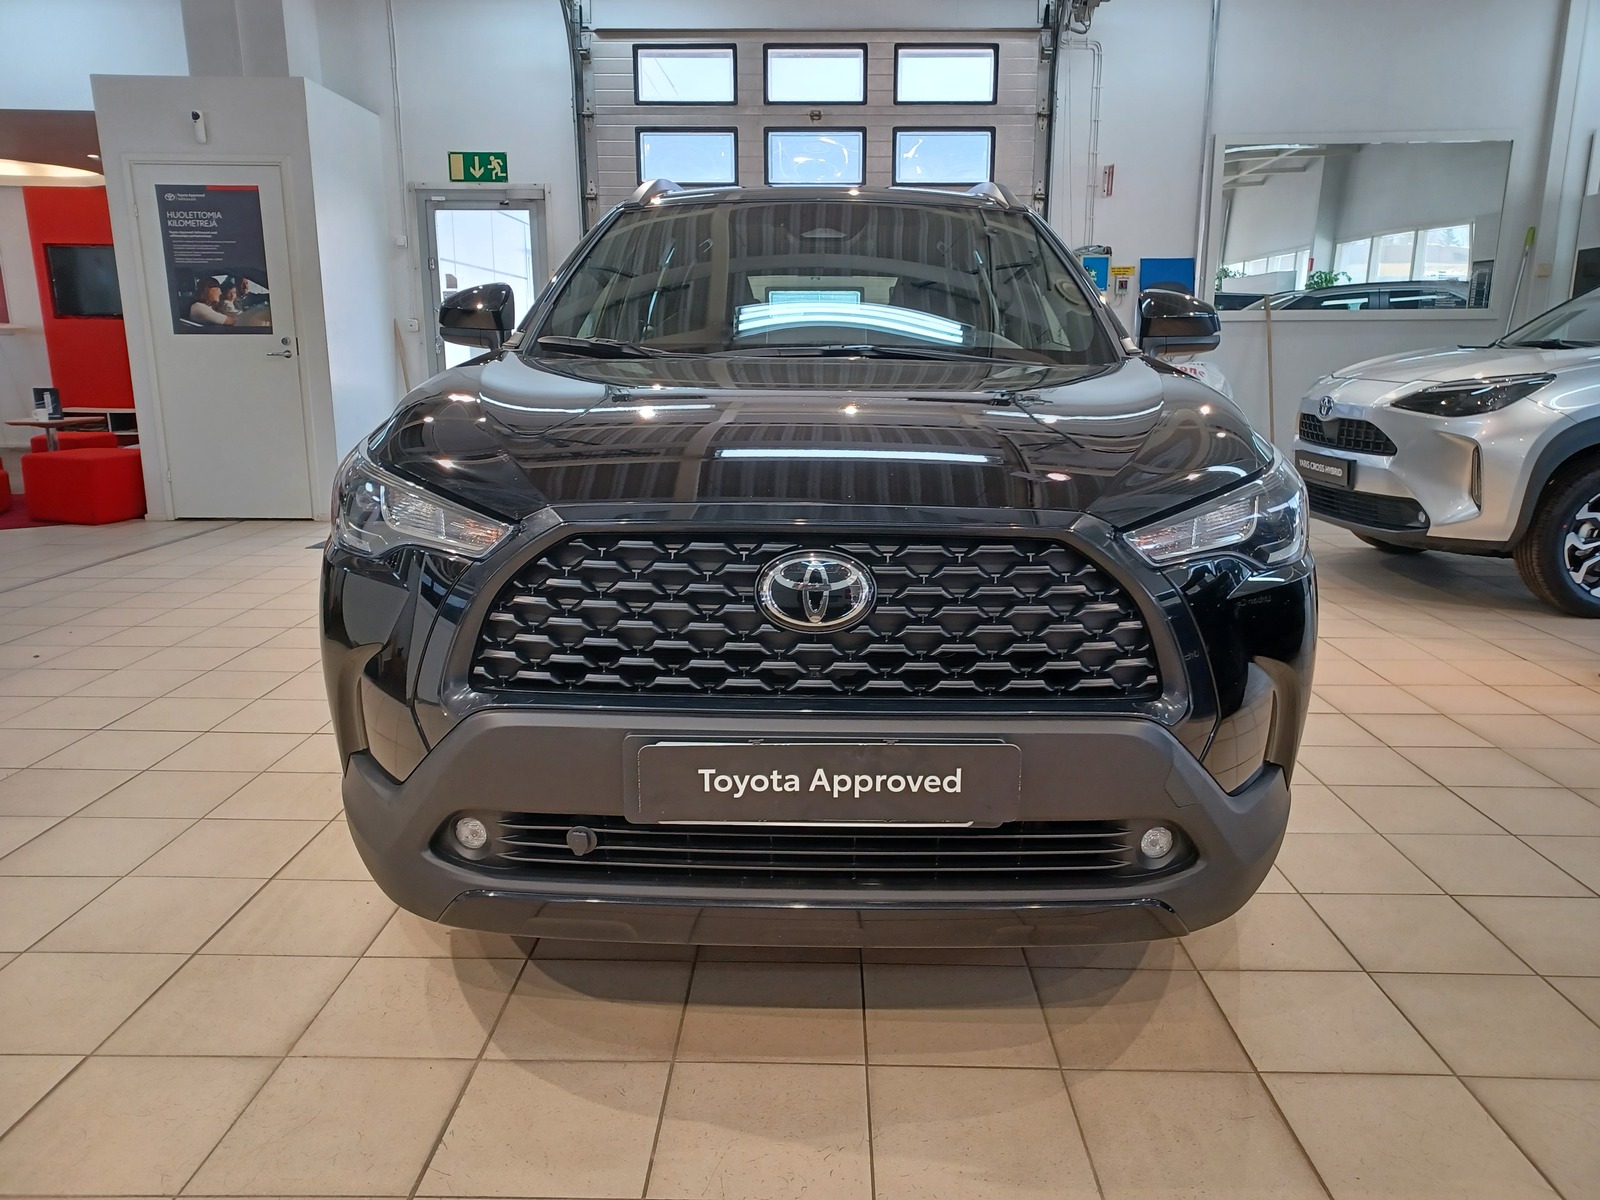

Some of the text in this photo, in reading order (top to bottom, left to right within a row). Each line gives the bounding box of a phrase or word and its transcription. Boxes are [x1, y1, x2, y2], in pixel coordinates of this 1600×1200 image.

[166, 211, 222, 219] HUOLETTOMIA
[167, 219, 217, 227] KILOMETREJÄ
[1298, 458, 1343, 477] YARIS CROSS HYBRID
[697, 768, 962, 798] Toyota Approved
